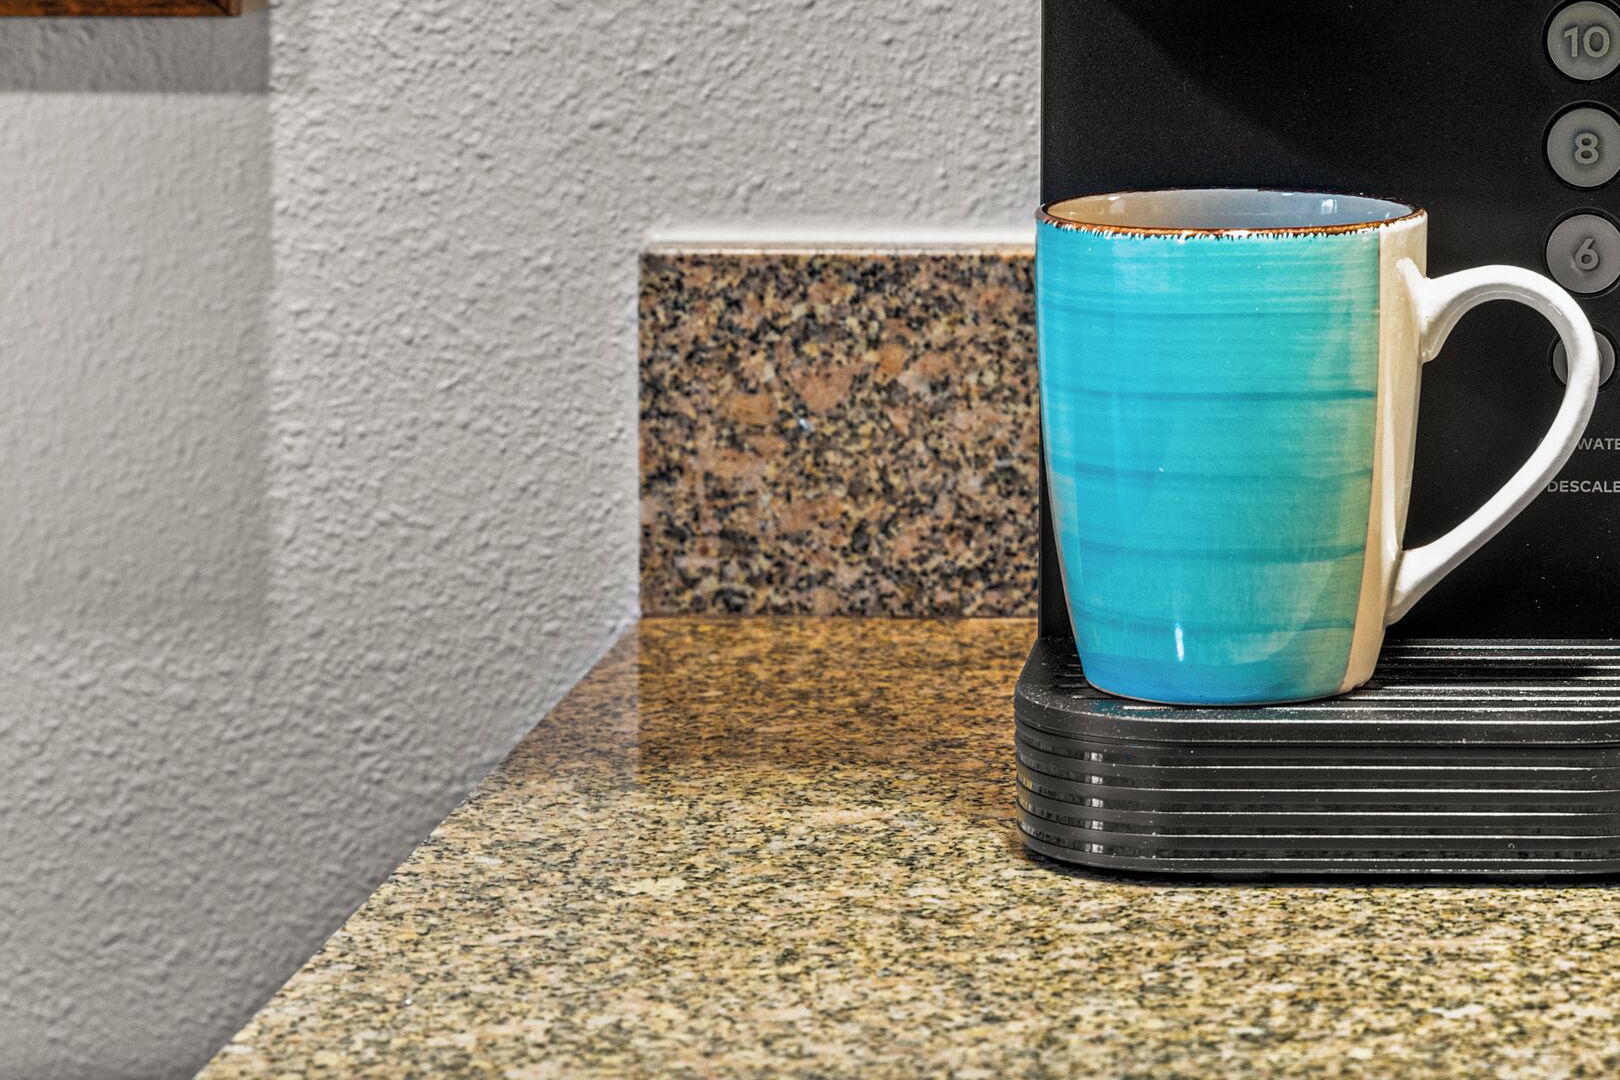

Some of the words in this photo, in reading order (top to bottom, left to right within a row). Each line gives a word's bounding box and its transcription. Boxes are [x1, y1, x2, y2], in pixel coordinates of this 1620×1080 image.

[1563, 25, 1611, 59] 10
[1574, 131, 1600, 165] 8
[1574, 237, 1599, 272] 6
